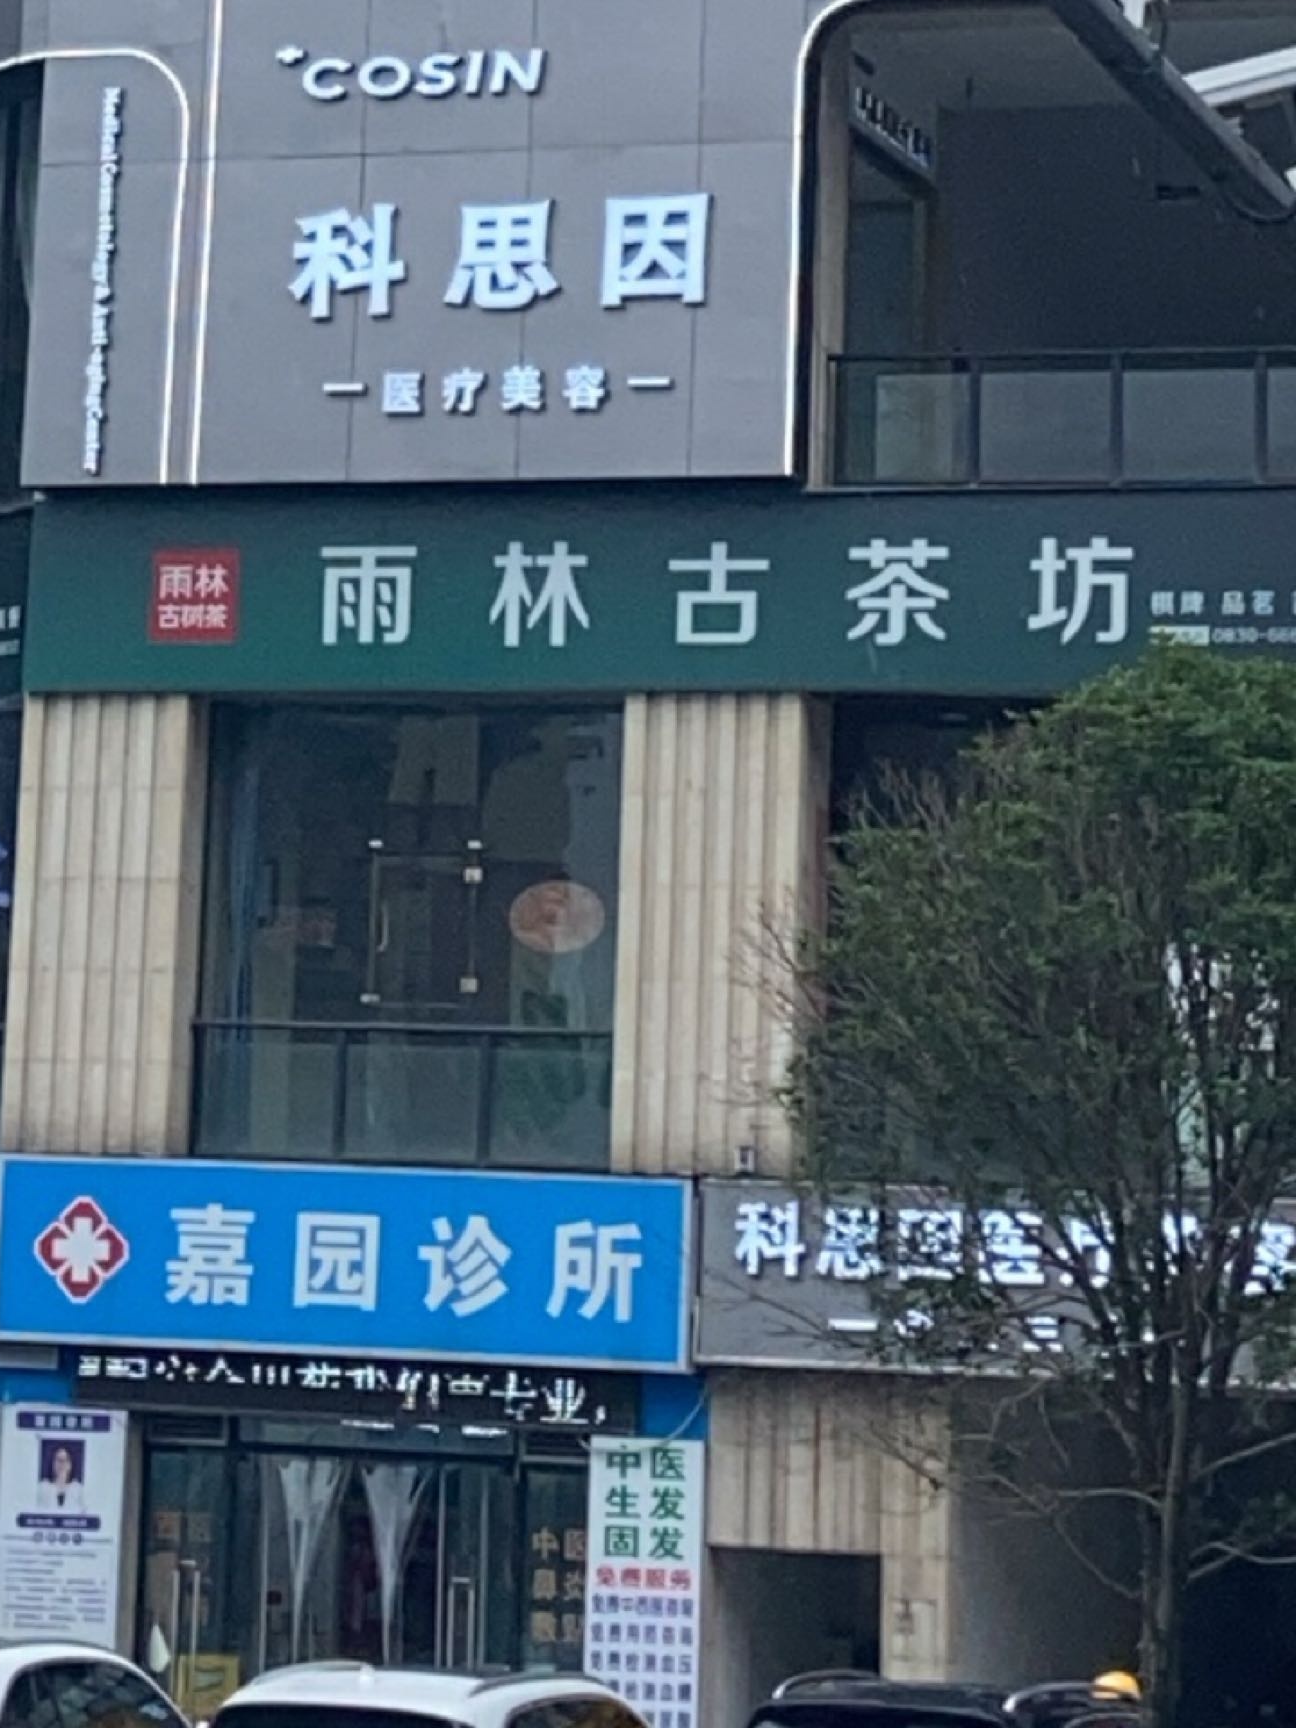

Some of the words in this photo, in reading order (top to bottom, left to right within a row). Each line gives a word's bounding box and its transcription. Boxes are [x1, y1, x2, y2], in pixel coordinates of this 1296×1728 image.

[301, 46, 547, 101] COSIN
[290, 192, 712, 321] 科思因
[380, 365, 608, 416] 医疗美容
[159, 564, 229, 600] 雨林
[320, 536, 1135, 649] 雨林古茶坊
[158, 603, 228, 629] 古树茶
[165, 1201, 644, 1324] 嘉园诊所
[605, 1445, 686, 1482] 中医
[605, 1484, 685, 1521] 生发
[604, 1524, 685, 1561] 固发
